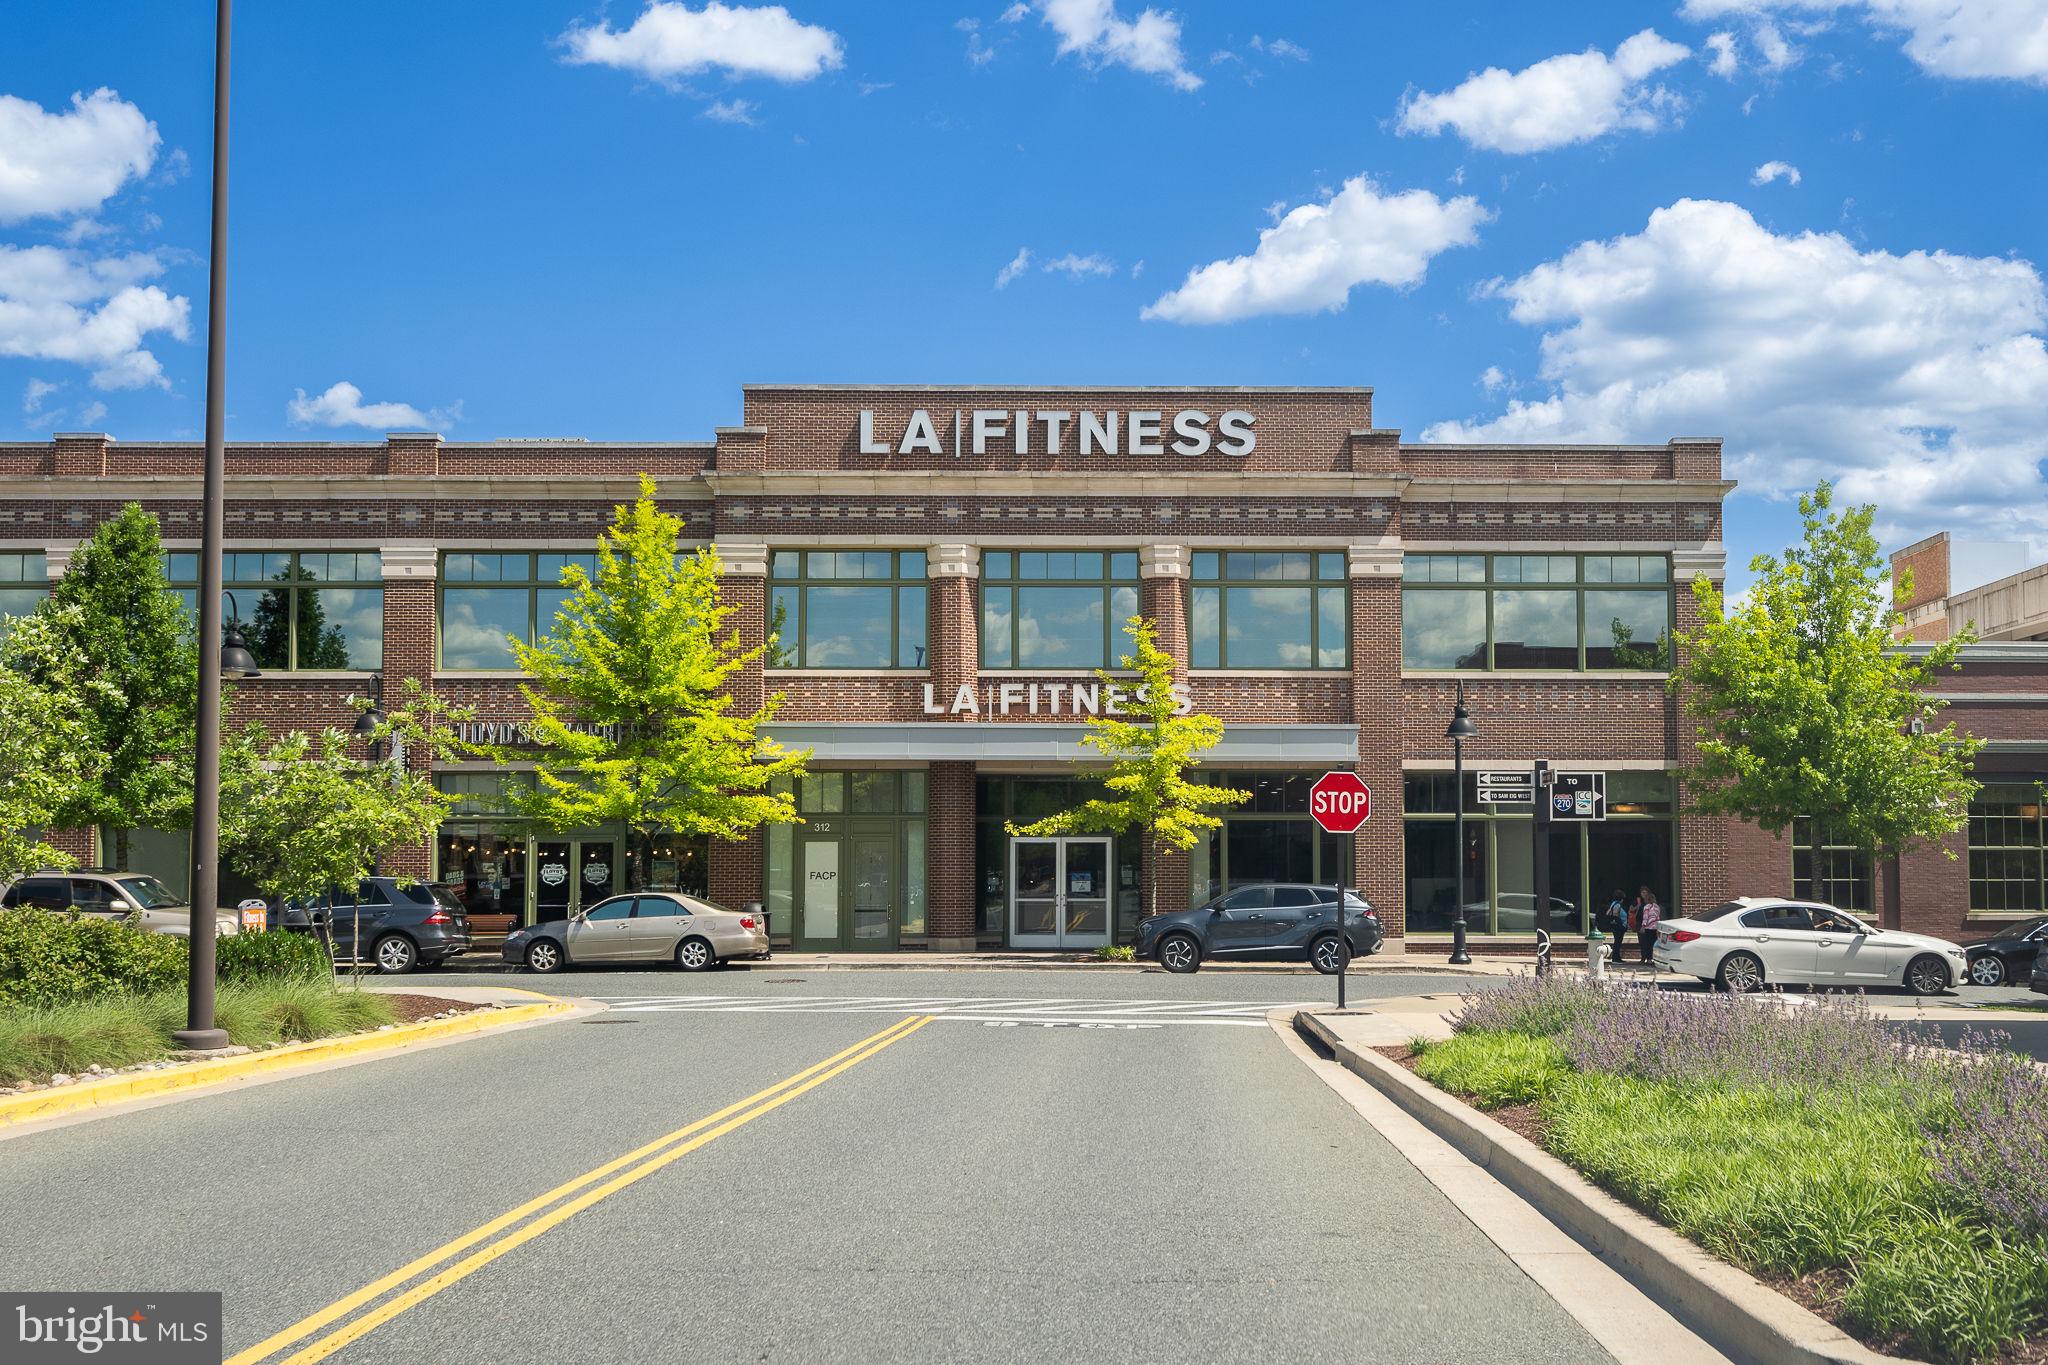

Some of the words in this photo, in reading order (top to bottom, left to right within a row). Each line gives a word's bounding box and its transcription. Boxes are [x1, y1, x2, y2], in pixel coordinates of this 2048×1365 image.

[859, 409, 944, 454] LA
[972, 409, 1257, 456] FITNESS
[923, 683, 981, 714] LA
[1576, 791, 1591, 800] ICC
[1314, 790, 1367, 814] STOP
[1557, 799, 1571, 808] 270
[814, 822, 830, 832] 312
[809, 871, 836, 880] FACP
